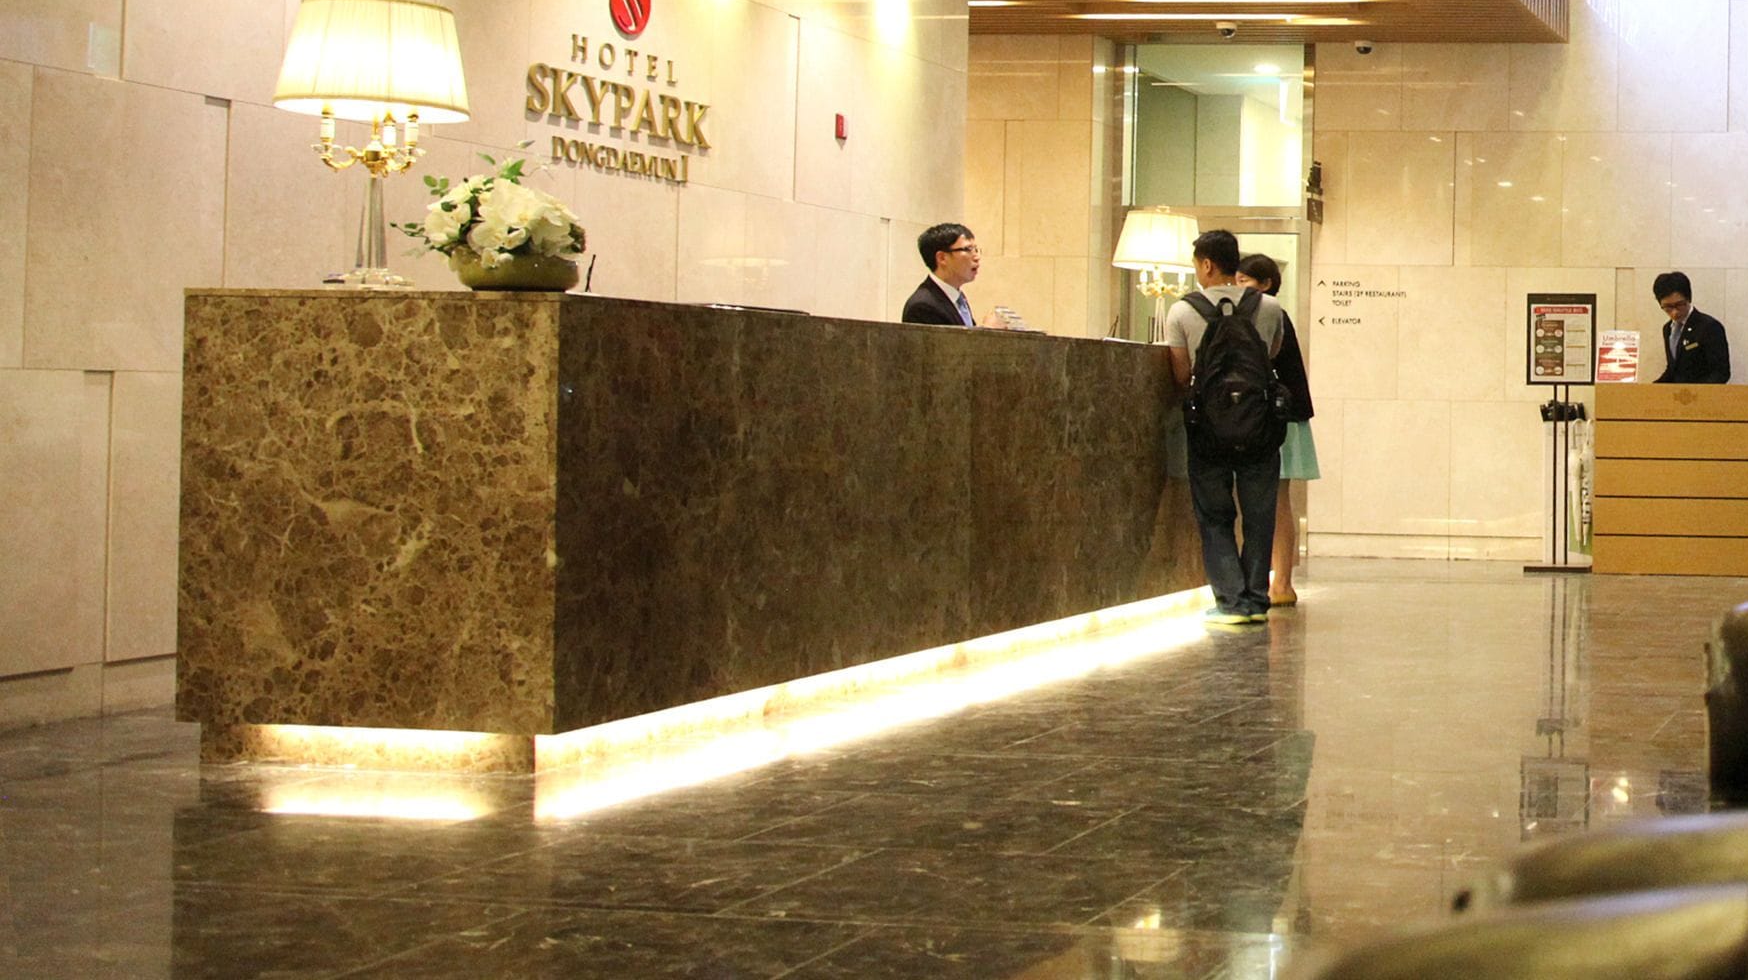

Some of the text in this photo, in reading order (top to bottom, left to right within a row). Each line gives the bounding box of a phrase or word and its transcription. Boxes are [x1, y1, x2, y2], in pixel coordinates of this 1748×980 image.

[571, 33, 678, 86] HOTEL
[526, 62, 712, 150] SKYPARK
[551, 135, 677, 181] DONGDAEMUN
[1602, 334, 1636, 342] Umbrella
